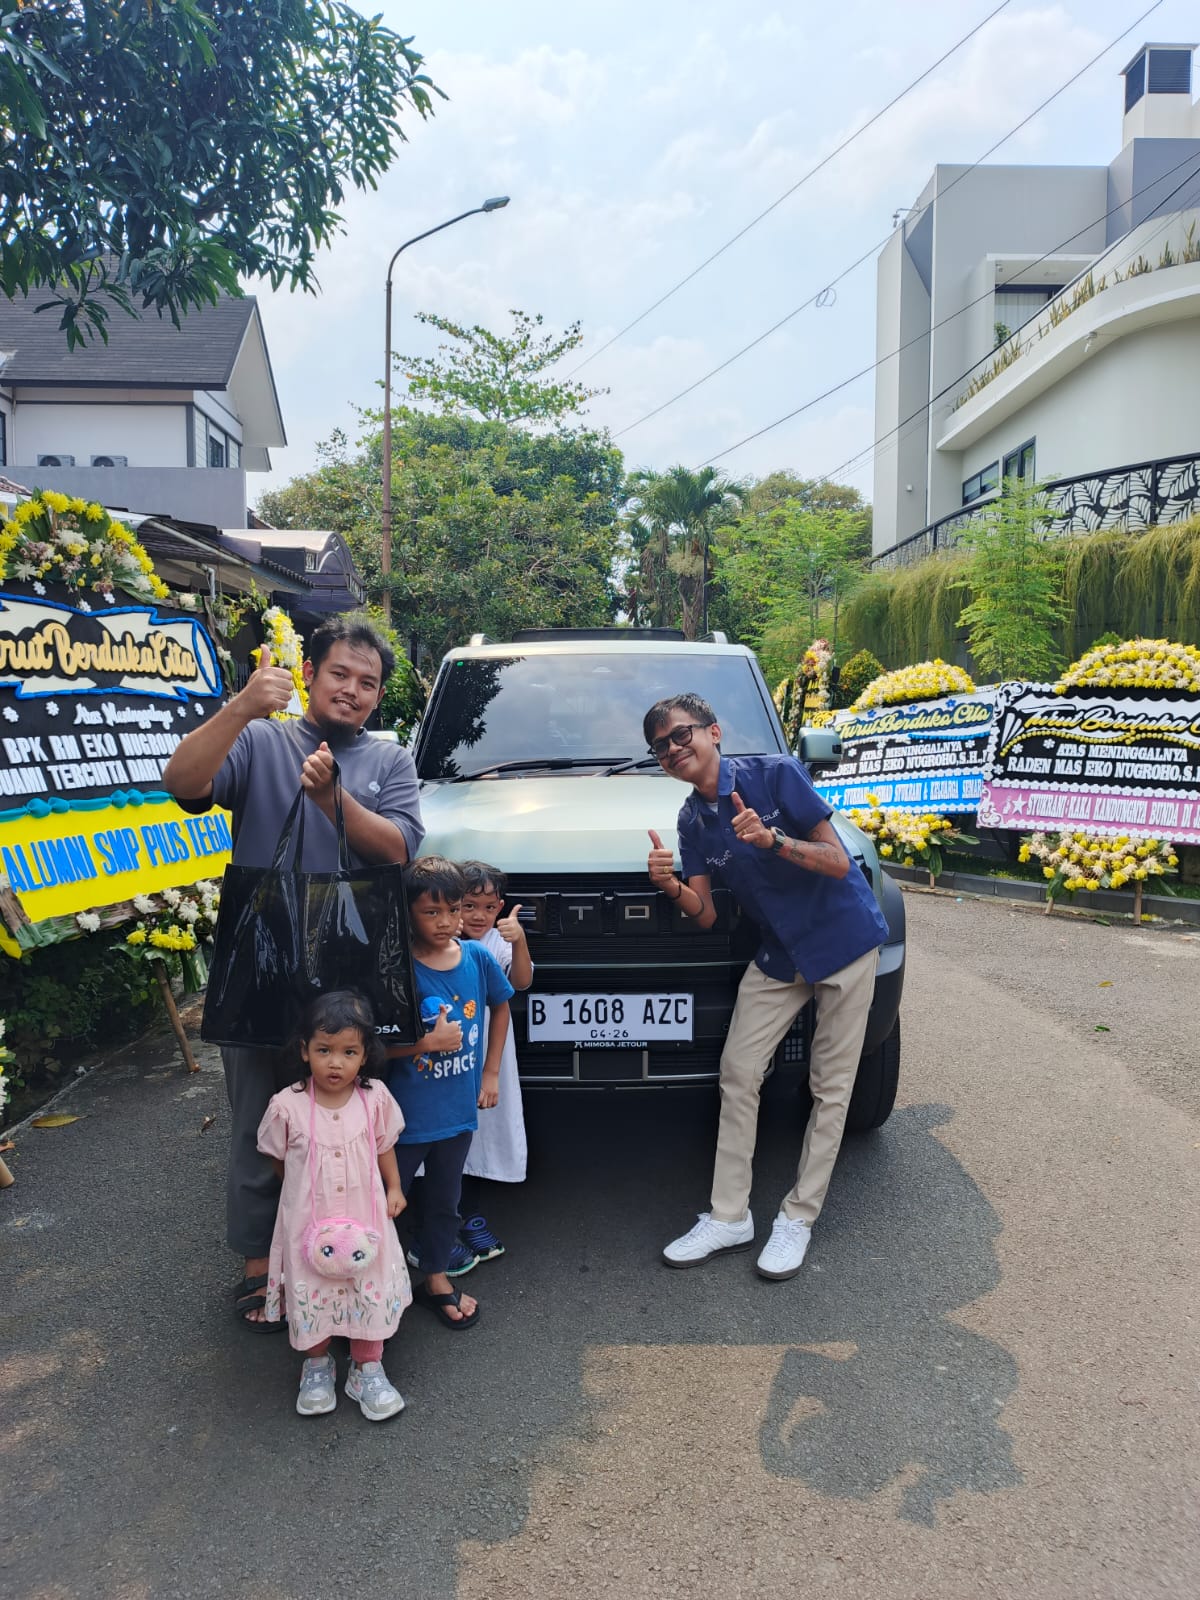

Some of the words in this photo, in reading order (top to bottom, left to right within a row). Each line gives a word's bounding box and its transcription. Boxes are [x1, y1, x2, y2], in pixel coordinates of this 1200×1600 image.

[0, 632, 53, 670] rut
[43, 623, 157, 675] Berduka
[151, 632, 196, 677] Cita
[836, 717, 878, 739] Turut
[877, 712, 952, 733] Berduka
[1021, 705, 1083, 728] Turut
[1081, 707, 1190, 730] Berduka
[3, 737, 48, 764] BPK
[49, 735, 81, 760] RM
[80, 733, 118, 758] EKO
[860, 748, 884, 762] ATAS
[885, 741, 962, 758] MENINGGALNYA
[1056, 743, 1087, 757] ATAS
[1088, 745, 1188, 762] MENINGGALNYA
[47, 761, 130, 790] TERCINTA
[858, 760, 881, 774] MAS
[883, 757, 904, 771] EKO
[1007, 757, 1052, 774] RADEN
[1054, 758, 1083, 775] MAS
[1085, 761, 1113, 777] EKO
[1149, 801, 1179, 827] BUNDA
[1181, 803, 1193, 828] DI
[1, 834, 98, 893] ALUMNI
[93, 828, 140, 876] SMP
[141, 821, 190, 867] PIUS
[531, 999, 546, 1026] B
[563, 998, 625, 1025] 1608
[643, 998, 688, 1025] AZC
[434, 1050, 476, 1080] SPACE
